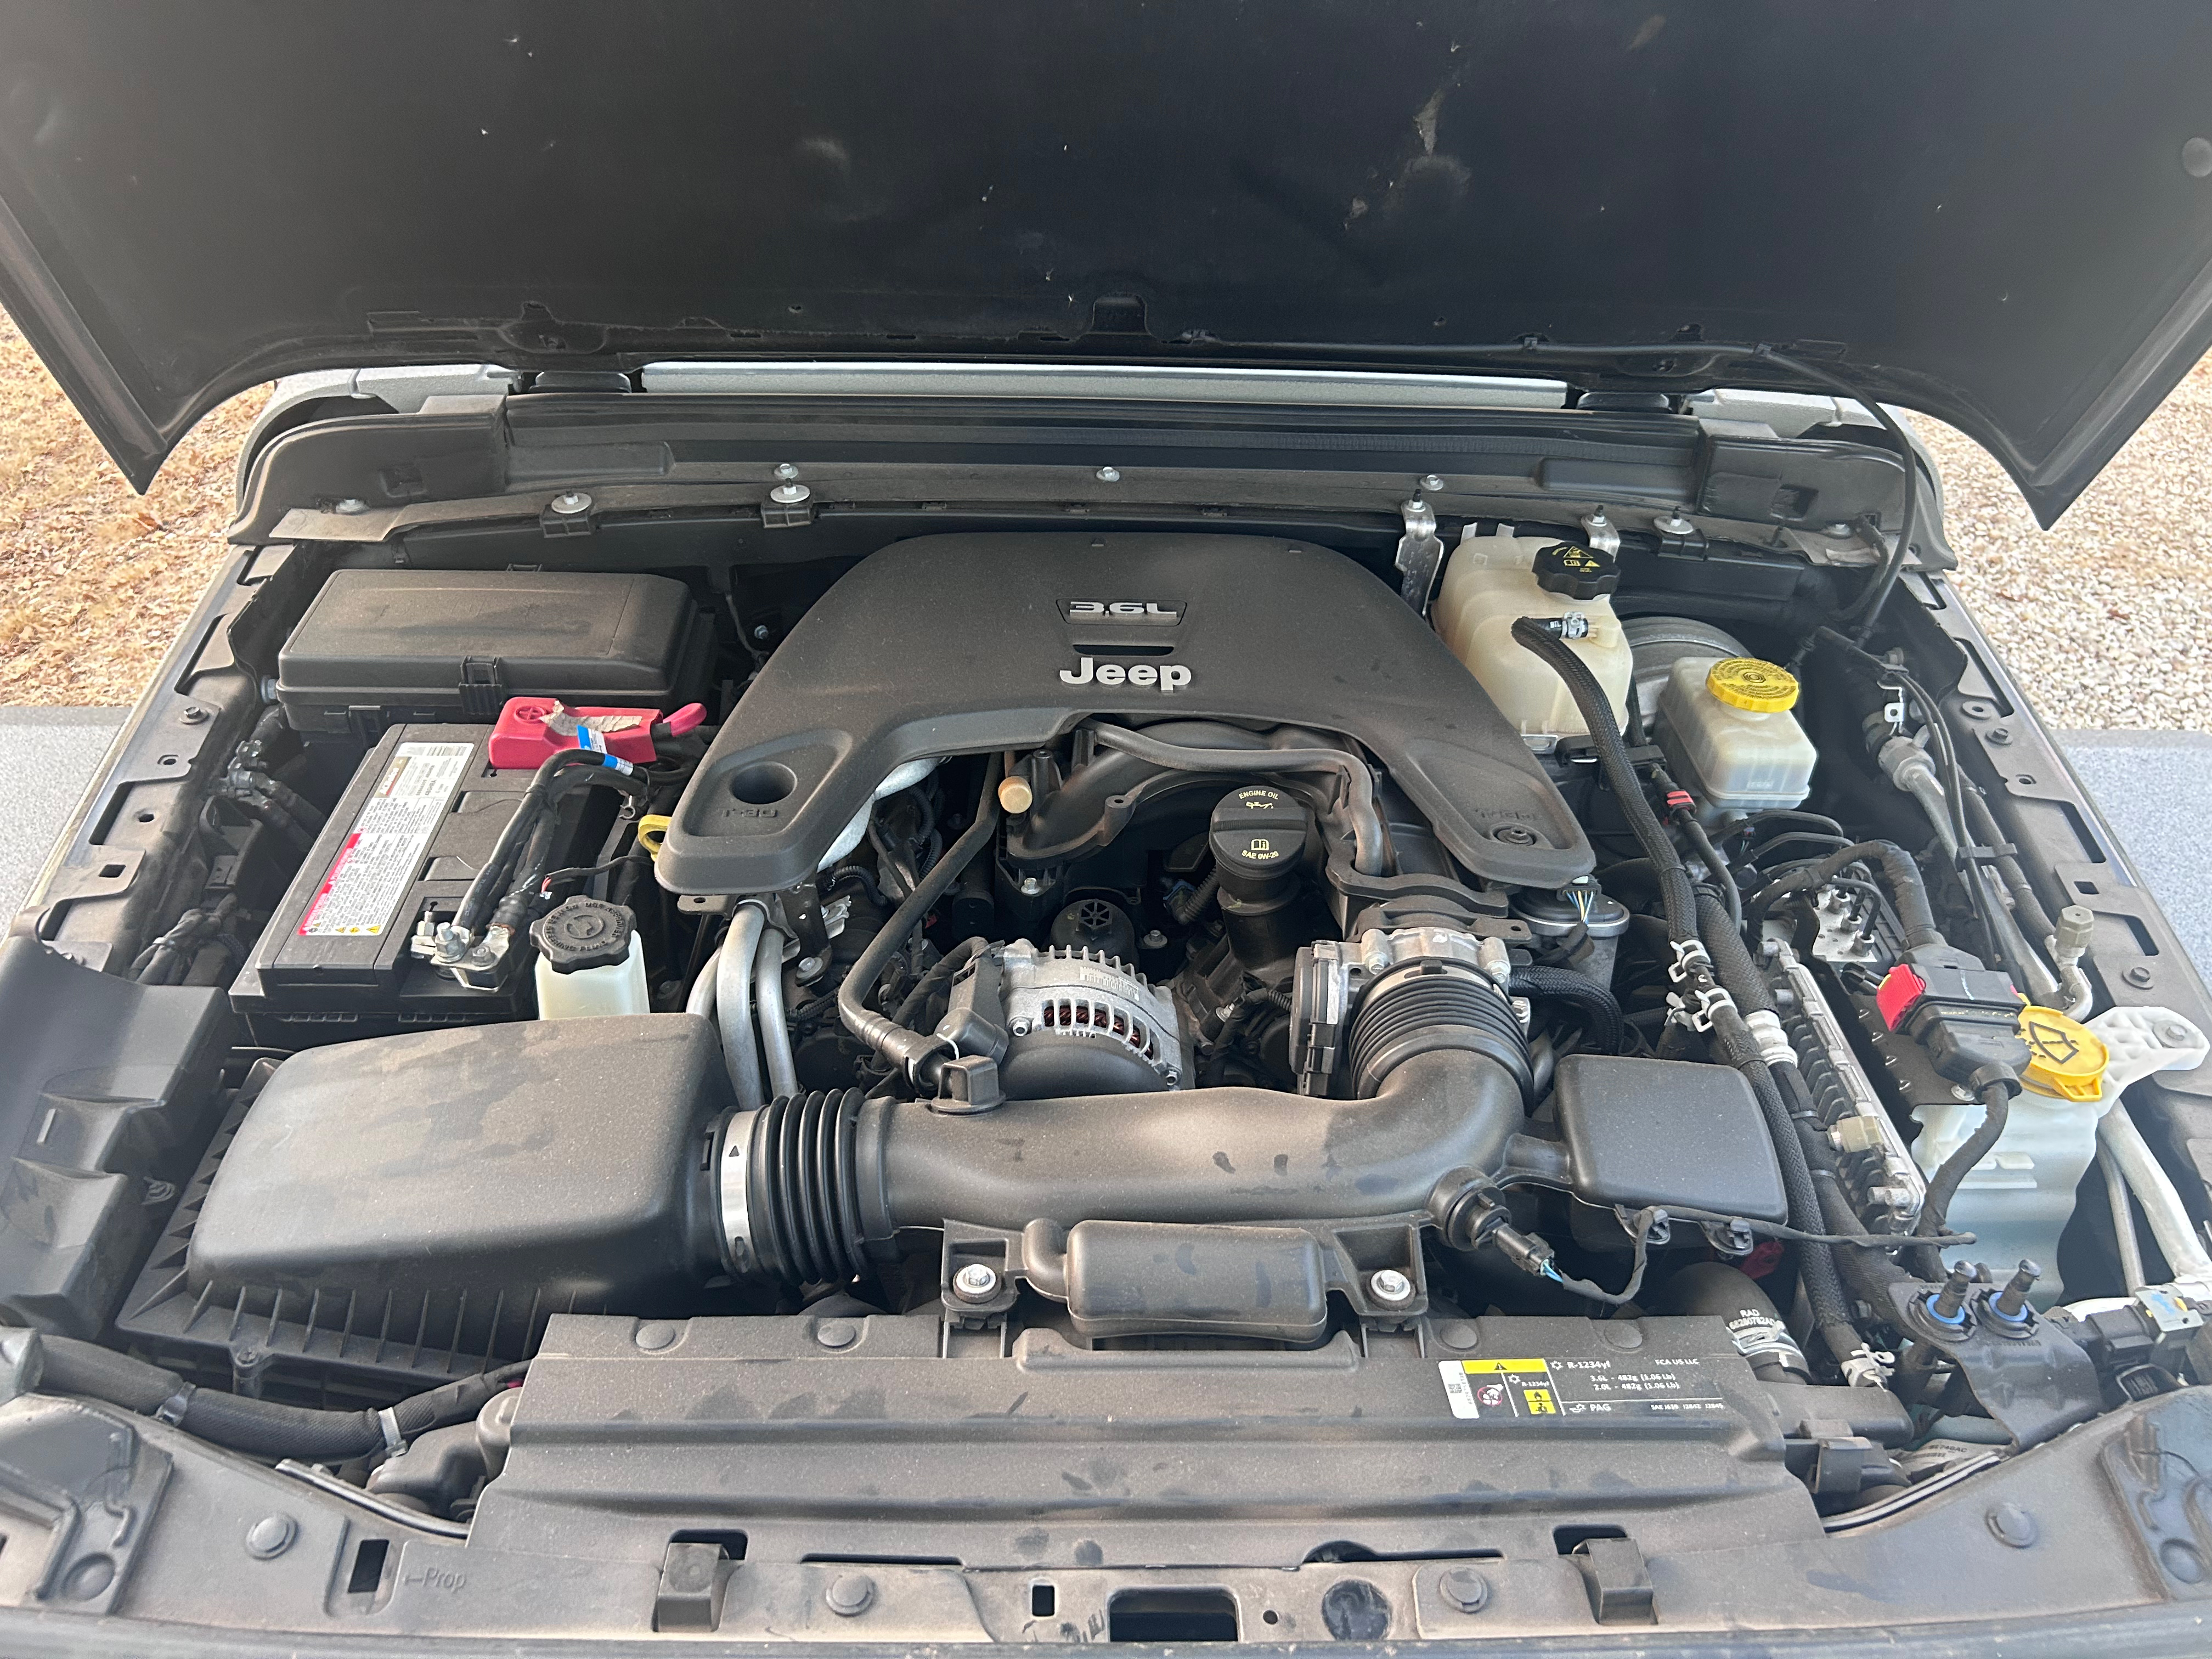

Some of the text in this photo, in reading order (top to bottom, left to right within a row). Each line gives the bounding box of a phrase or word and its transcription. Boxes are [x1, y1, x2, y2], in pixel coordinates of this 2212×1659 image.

[1070, 601, 1177, 619] 3.6L
[1059, 657, 1192, 691] Jeep
[1238, 790, 1279, 800] ENGINE OIL
[1241, 850, 1279, 860] SAE 0W-20
[1740, 1309, 1760, 1318] RAD
[1567, 1361, 1611, 1369] R-1234yf
[1589, 1403, 1612, 1412] PAG
[422, 1567, 467, 1594] Prop
